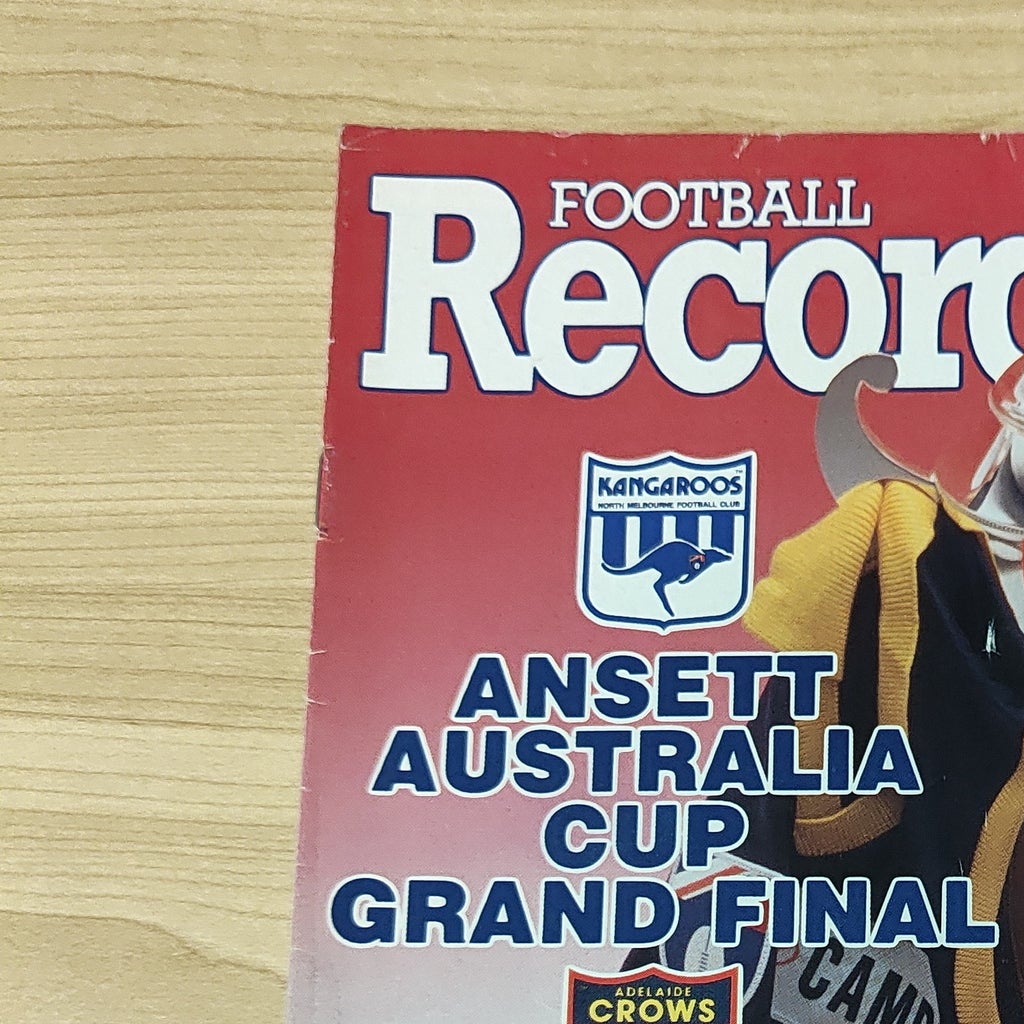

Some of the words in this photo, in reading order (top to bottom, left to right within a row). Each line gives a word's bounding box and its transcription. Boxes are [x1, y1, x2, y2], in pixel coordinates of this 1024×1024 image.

[548, 179, 871, 229] FOOTBALL
[598, 476, 743, 497] KANGAROOS
[452, 653, 837, 723] ANSETT
[369, 726, 923, 795] AUSTRALIA
[540, 801, 749, 872] CUP
[329, 875, 680, 948] GRAND
[709, 876, 1000, 948] FINAL
[588, 998, 716, 1024] CROWS
[614, 986, 692, 997] ADELAIDE
